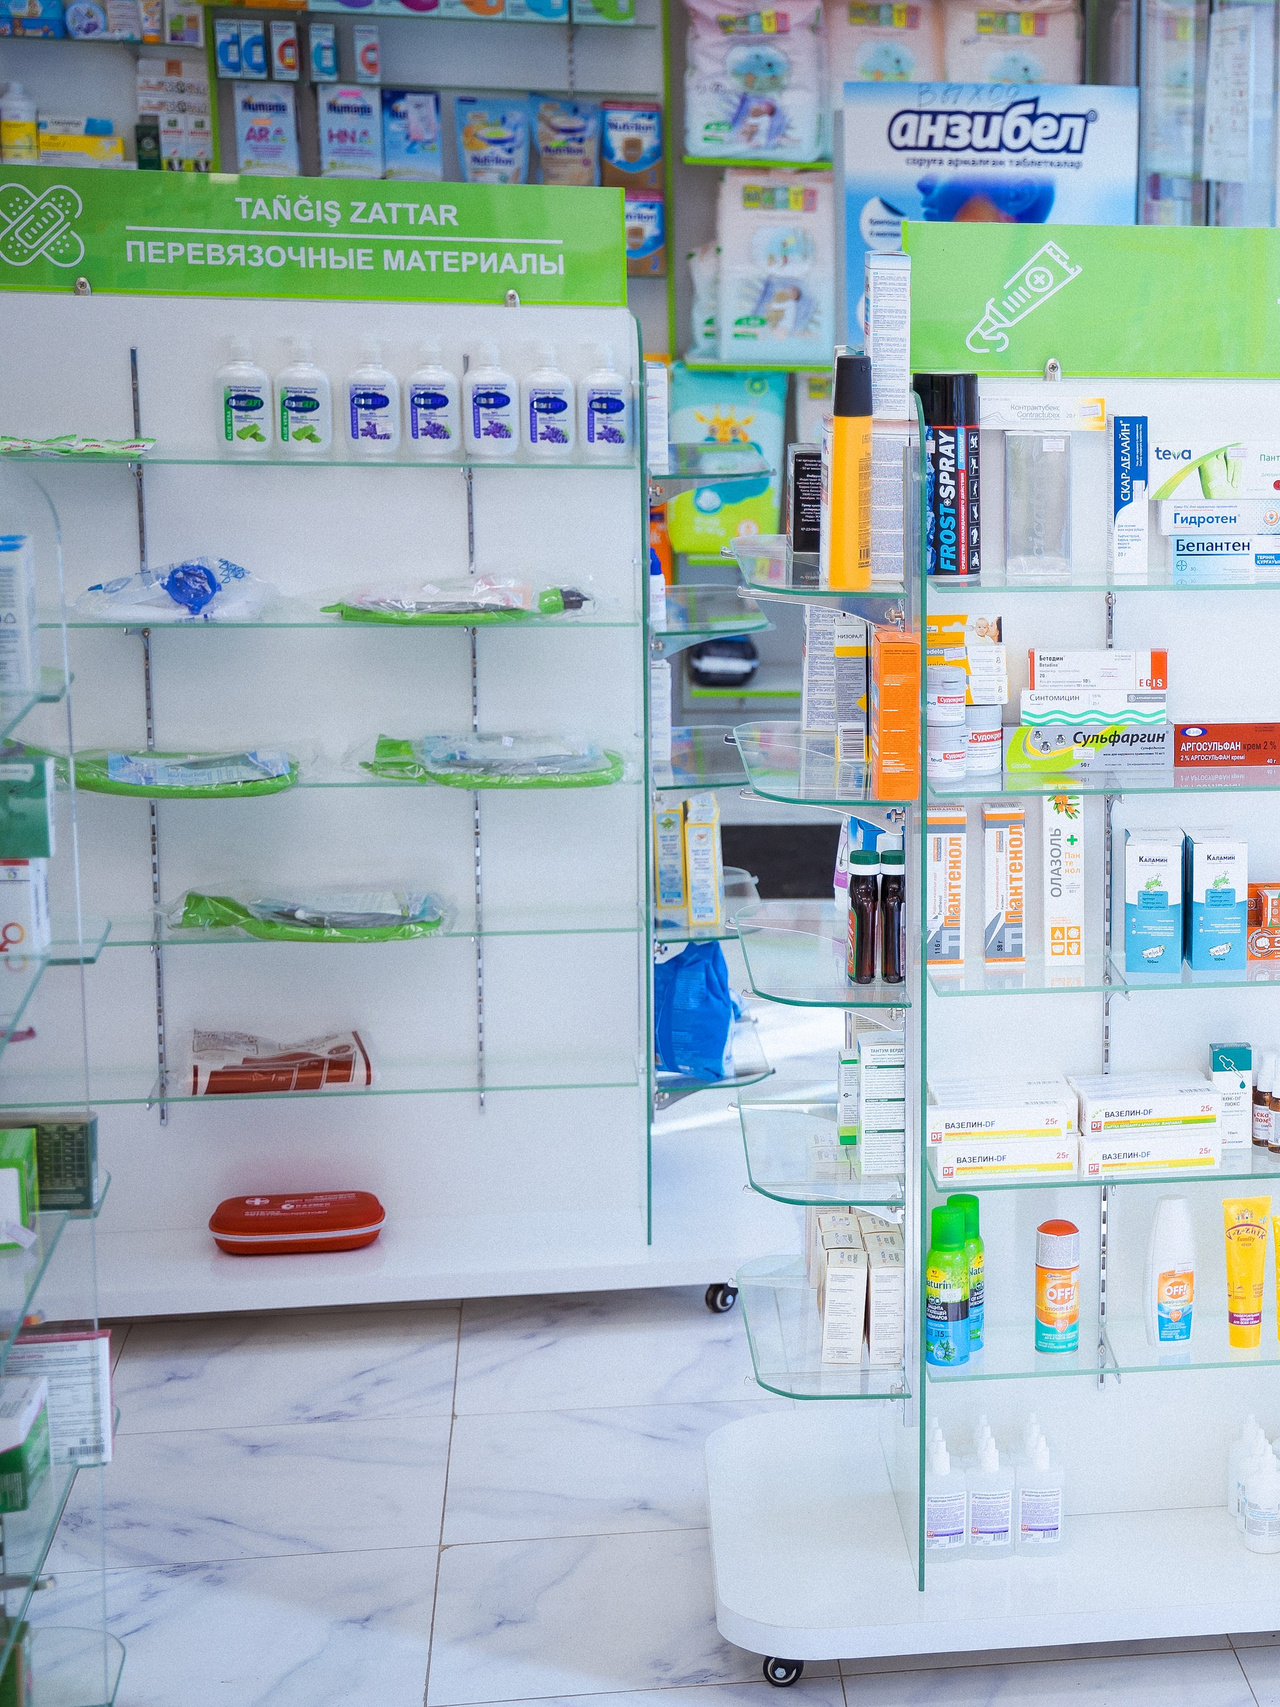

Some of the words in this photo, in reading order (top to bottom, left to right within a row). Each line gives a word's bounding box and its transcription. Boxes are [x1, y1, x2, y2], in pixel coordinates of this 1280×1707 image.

[888, 97, 1088, 154] анзибел
[235, 194, 342, 228] TAÑĞIŞ
[350, 201, 459, 226] ZATTAR
[126, 240, 374, 270] ПЕРЕВЯЗОЧНЫЕ
[383, 249, 565, 275] МАТЕРИАЛЫ
[1155, 447, 1192, 460] teva
[938, 430, 956, 500] SPRAY
[1119, 423, 1130, 501] СКАР-ДЕЛАЙН
[1173, 512, 1237, 527] Гидротен
[939, 503, 957, 571] FROST
[1176, 539, 1250, 552] Бепантен
[1139, 679, 1163, 687] EGIS
[1029, 694, 1080, 702] Синтомицин
[1073, 730, 1165, 747] Сульфаргин
[1181, 741, 1241, 752] АРГОСУЛЬФАН
[1243, 743, 1261, 752] крем
[1269, 741, 1277, 749] %
[1065, 852, 1080, 860] Пан
[1050, 828, 1062, 898] ОЛАЗОЛЬ
[1005, 824, 1023, 923] Пантенол
[944, 837, 962, 927] Пантенол
[1105, 1109, 1153, 1118] ВАЗЕЛИН-DF
[944, 1120, 996, 1130] ВАЗЕЛИН-DF
[1045, 1118, 1058, 1126] 25г
[932, 1133, 942, 1141] DF
[956, 1155, 1007, 1164] ВАЗЕЛИН-DF
[1056, 1152, 1069, 1160] 25г
[1102, 1151, 1151, 1160] ВАЗЕЛИН-DF
[944, 1167, 953, 1175] DF
[1046, 1286, 1075, 1300] OFF!
[1164, 1283, 1187, 1296] OFF!
